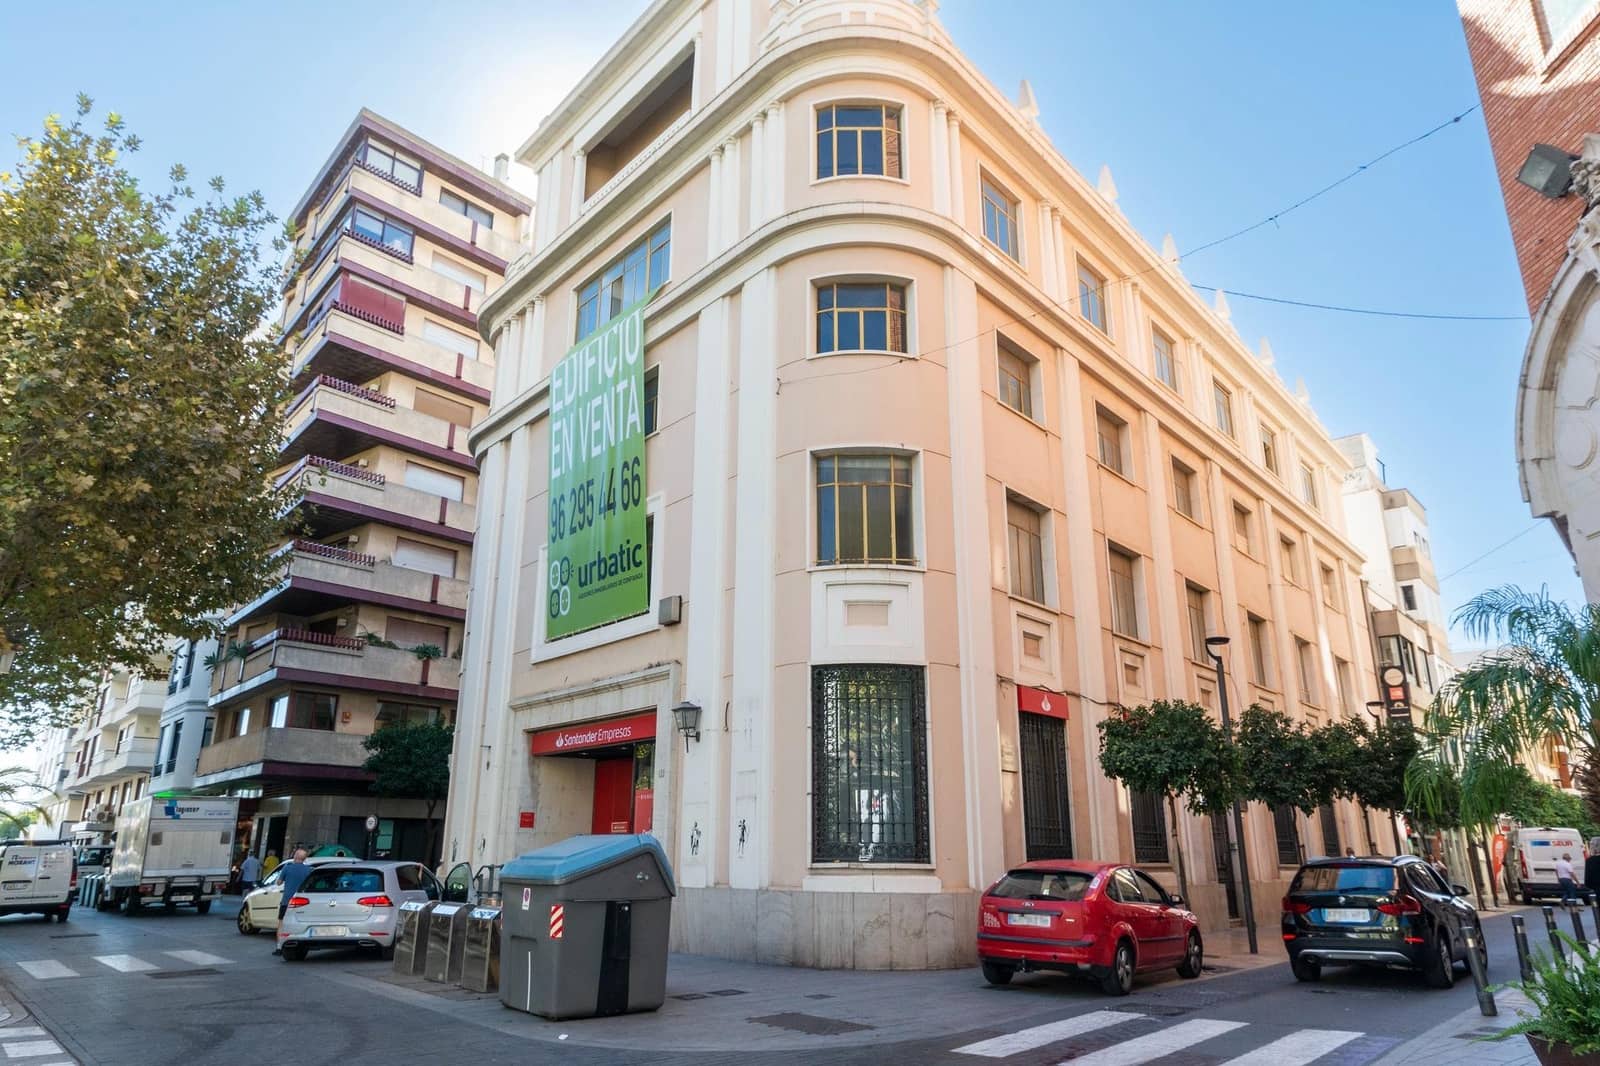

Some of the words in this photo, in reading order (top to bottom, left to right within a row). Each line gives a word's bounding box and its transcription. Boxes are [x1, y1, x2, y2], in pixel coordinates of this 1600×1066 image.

[552, 308, 640, 413] EDIFICIO
[552, 412, 574, 479] EN
[579, 375, 641, 463] VENTA
[551, 493, 565, 544] 96
[569, 478, 594, 535] 295
[599, 467, 616, 520] 44
[621, 456, 641, 511] 66
[578, 539, 642, 587] urbatic
[564, 732, 598, 746] Santander
[598, 726, 632, 743] Empresas
